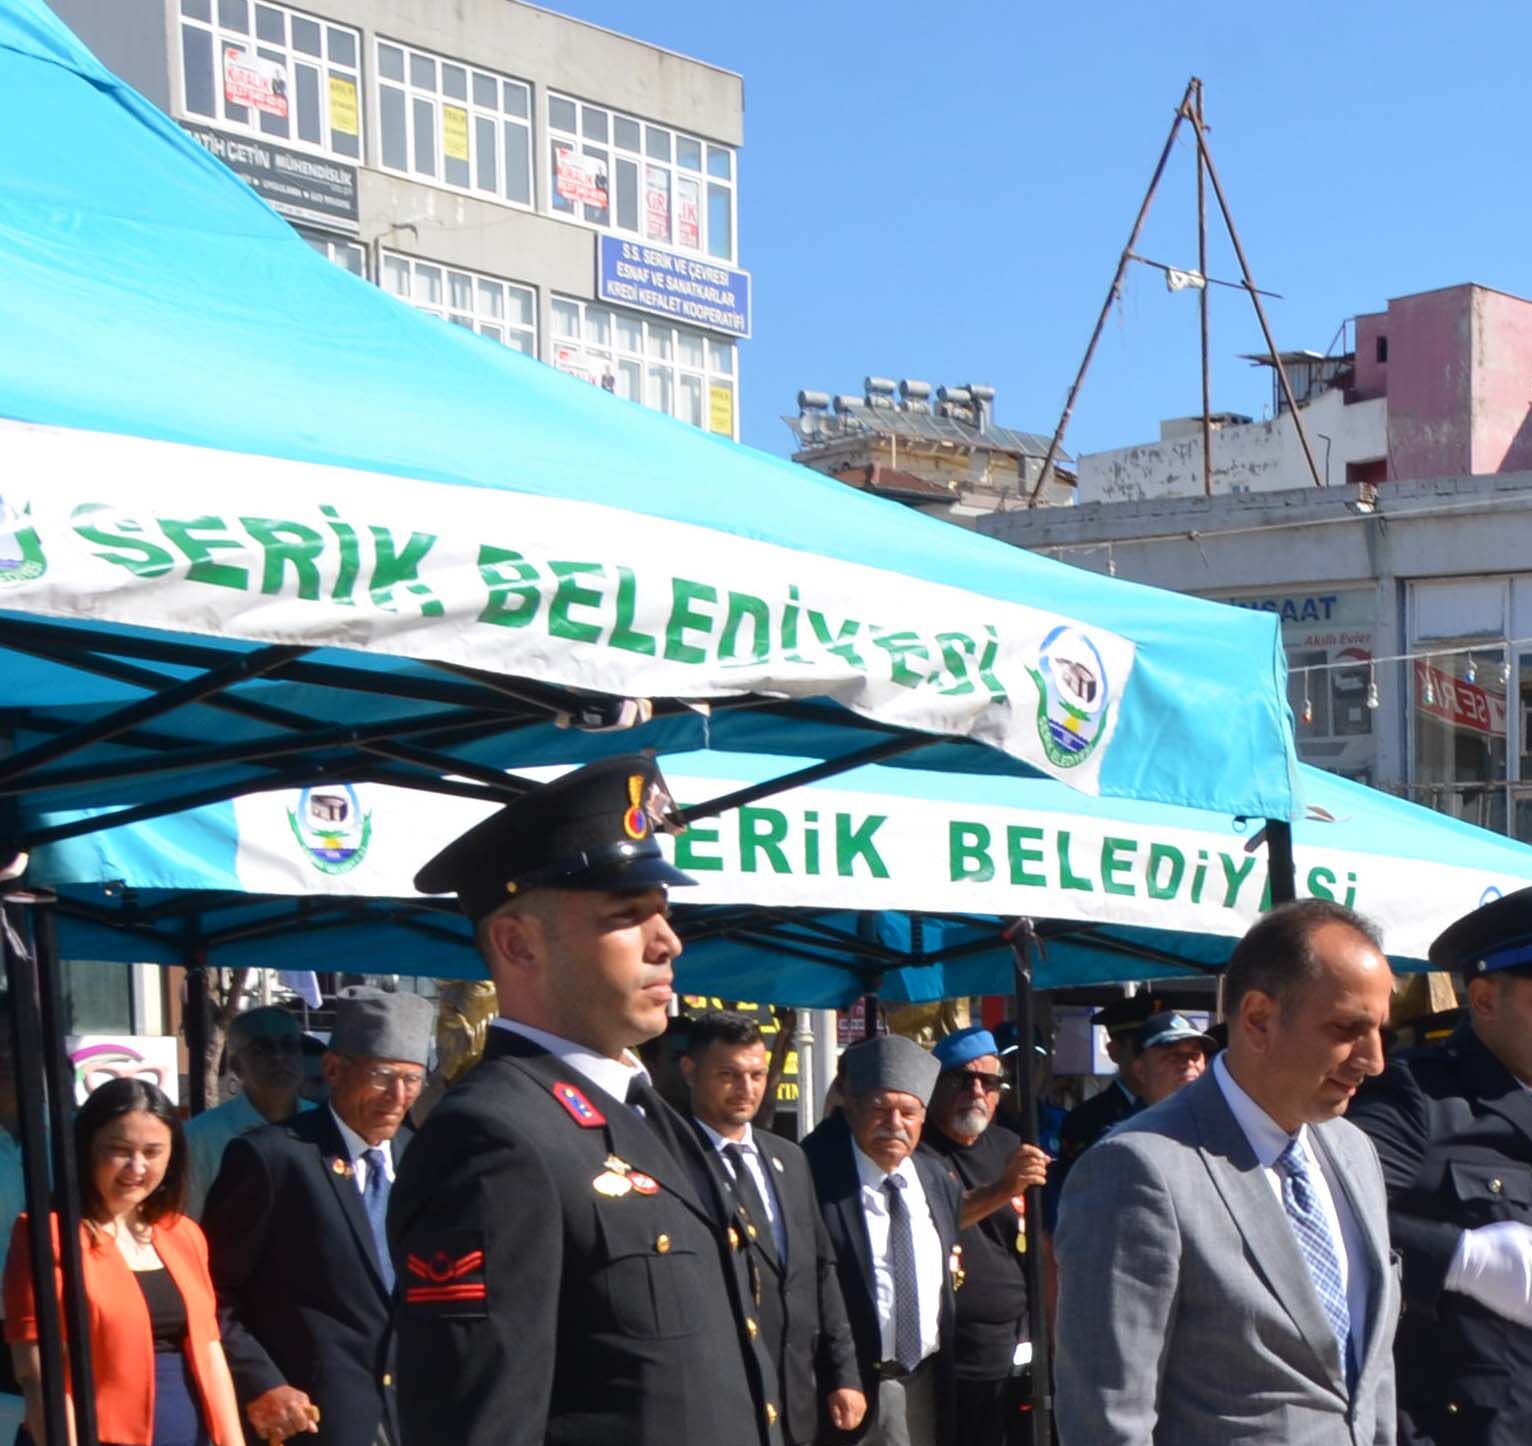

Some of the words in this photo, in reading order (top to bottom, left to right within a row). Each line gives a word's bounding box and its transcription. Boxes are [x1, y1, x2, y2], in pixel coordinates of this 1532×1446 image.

[643, 248, 673, 270] SERİK
[674, 257, 688, 274] VE
[607, 280, 638, 300] KREDİ
[638, 288, 682, 311] KEFALET
[616, 261, 650, 284] ESNAF
[651, 271, 664, 288] VE
[665, 275, 735, 308] SANATKARLAR
[71, 502, 445, 617] SERİK
